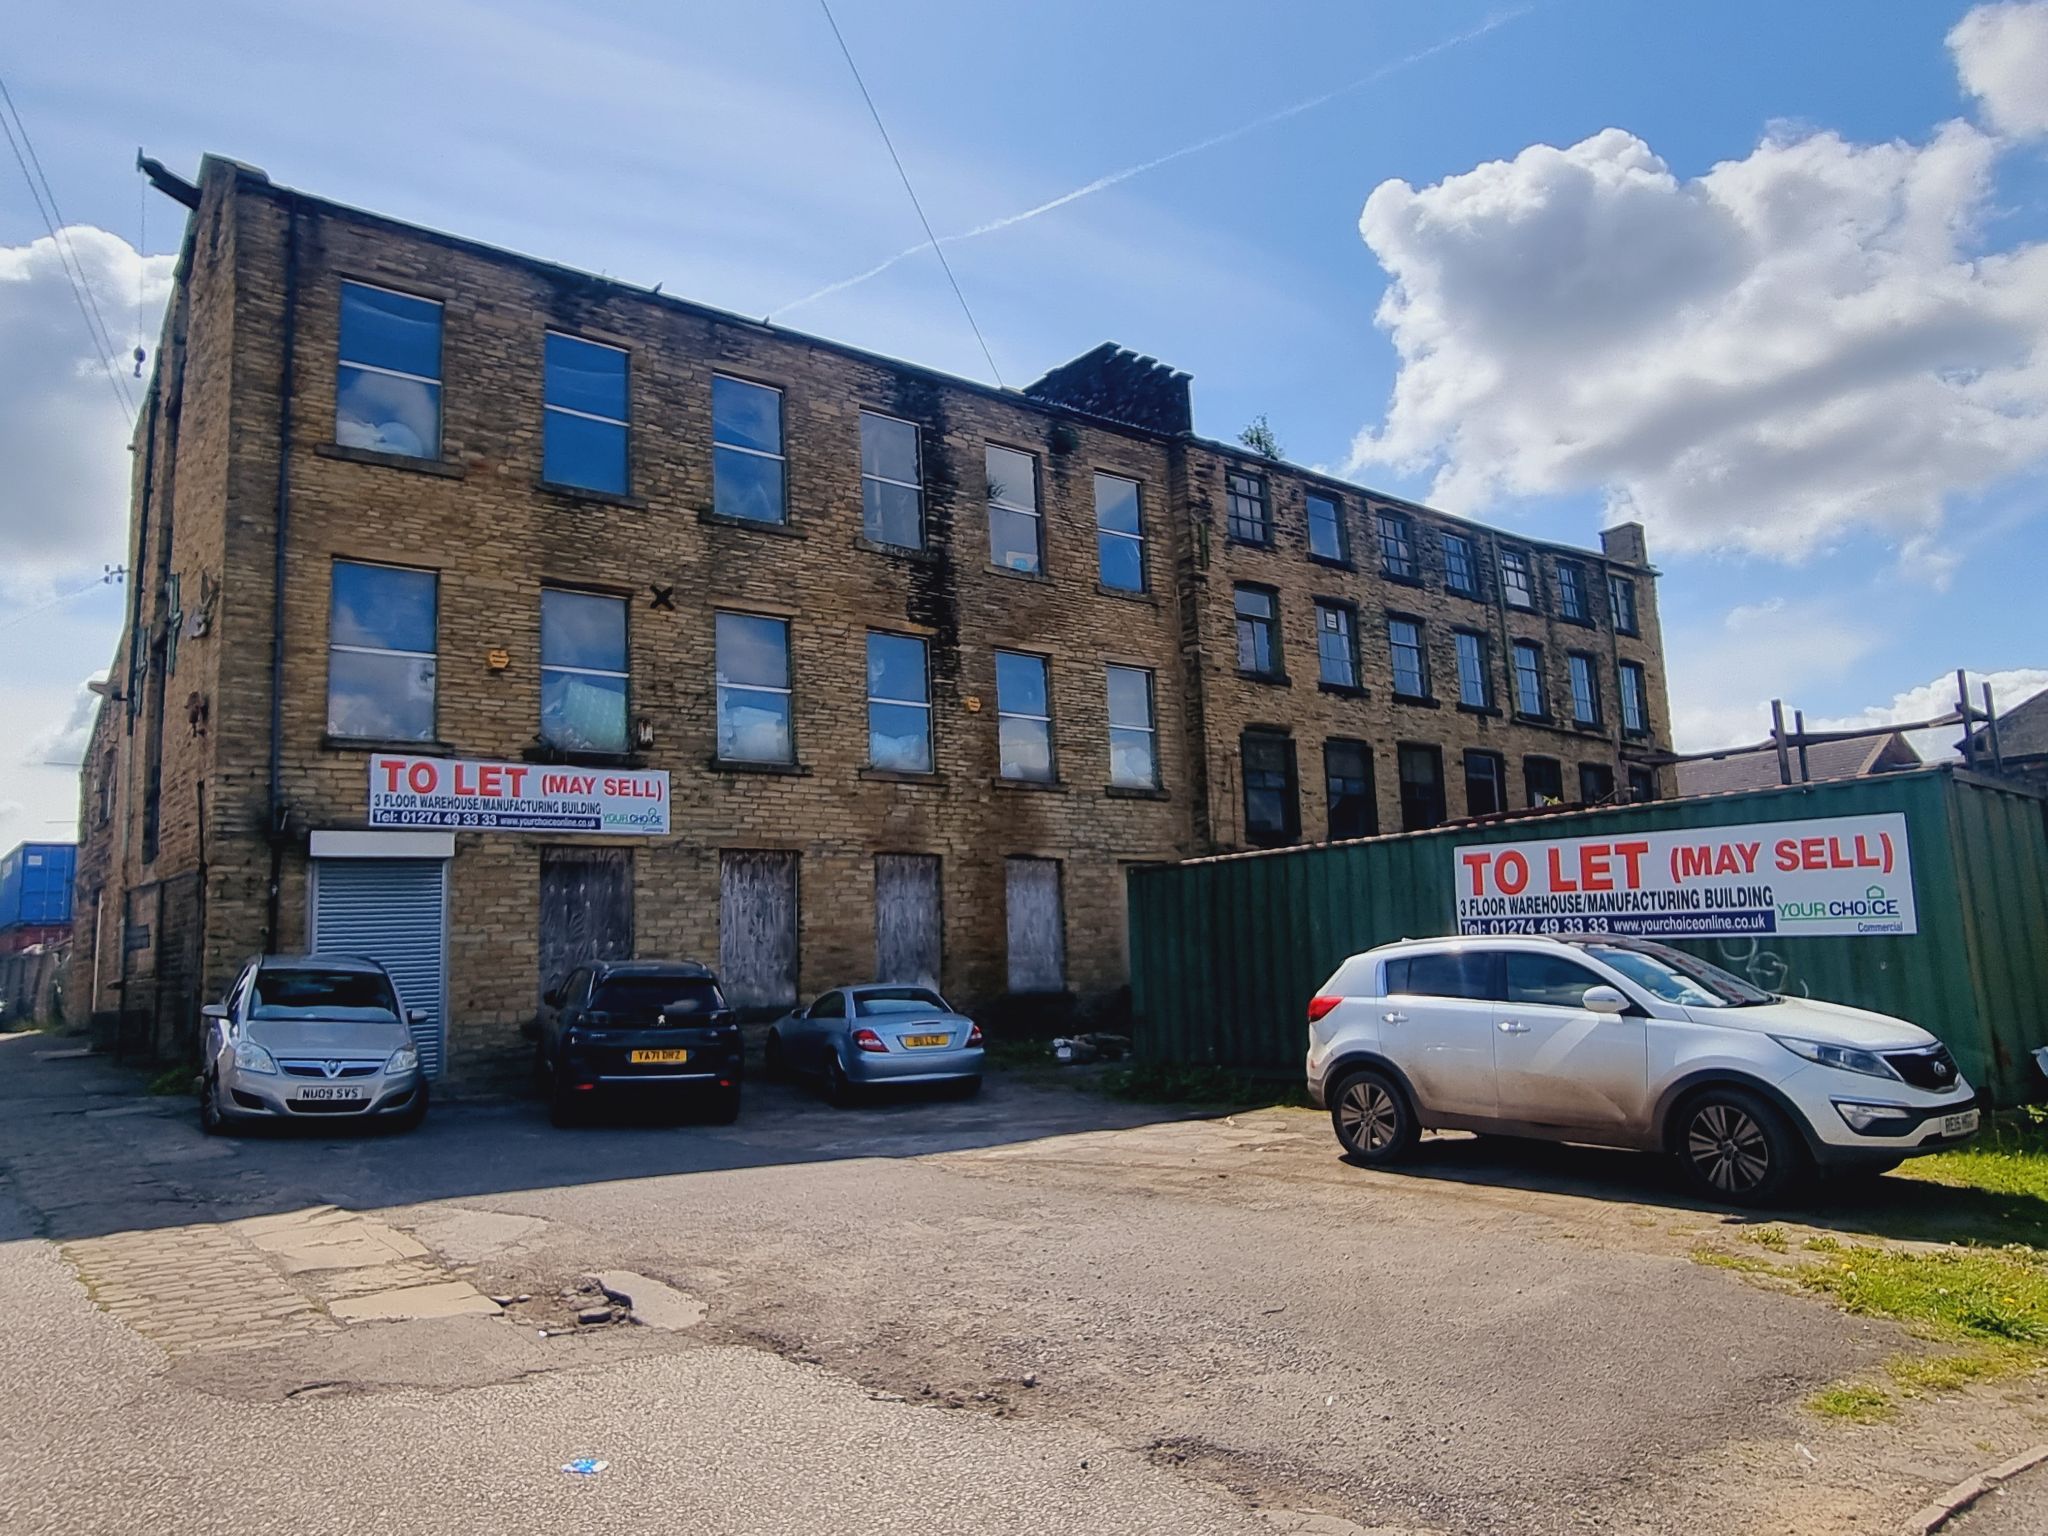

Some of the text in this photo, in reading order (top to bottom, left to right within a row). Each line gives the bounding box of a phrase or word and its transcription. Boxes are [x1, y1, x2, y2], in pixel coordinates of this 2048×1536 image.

[379, 760, 663, 802] TO LET (MAY SELL)
[374, 793, 601, 815] 3 FLOOR WAREHOUSE/MANUFACTURING BUILDING
[375, 810, 596, 829] Tel: 01274 49 33 33 www.yourchoiceonline.co.uk
[603, 814, 628, 823] YOUR
[1462, 832, 1894, 897] TO LET (MAY SELL)
[1460, 886, 1774, 917] 3 FLOOR WAREHOUSE/MANUFACTURING BUILDING
[1777, 902, 1827, 918] YOUR
[1462, 913, 1766, 935] Tel: 01274 49 33 33 www.yourchoiceonline.co.uk
[1857, 921, 1904, 933] Commercial
[302, 1087, 334, 1099] NU09
